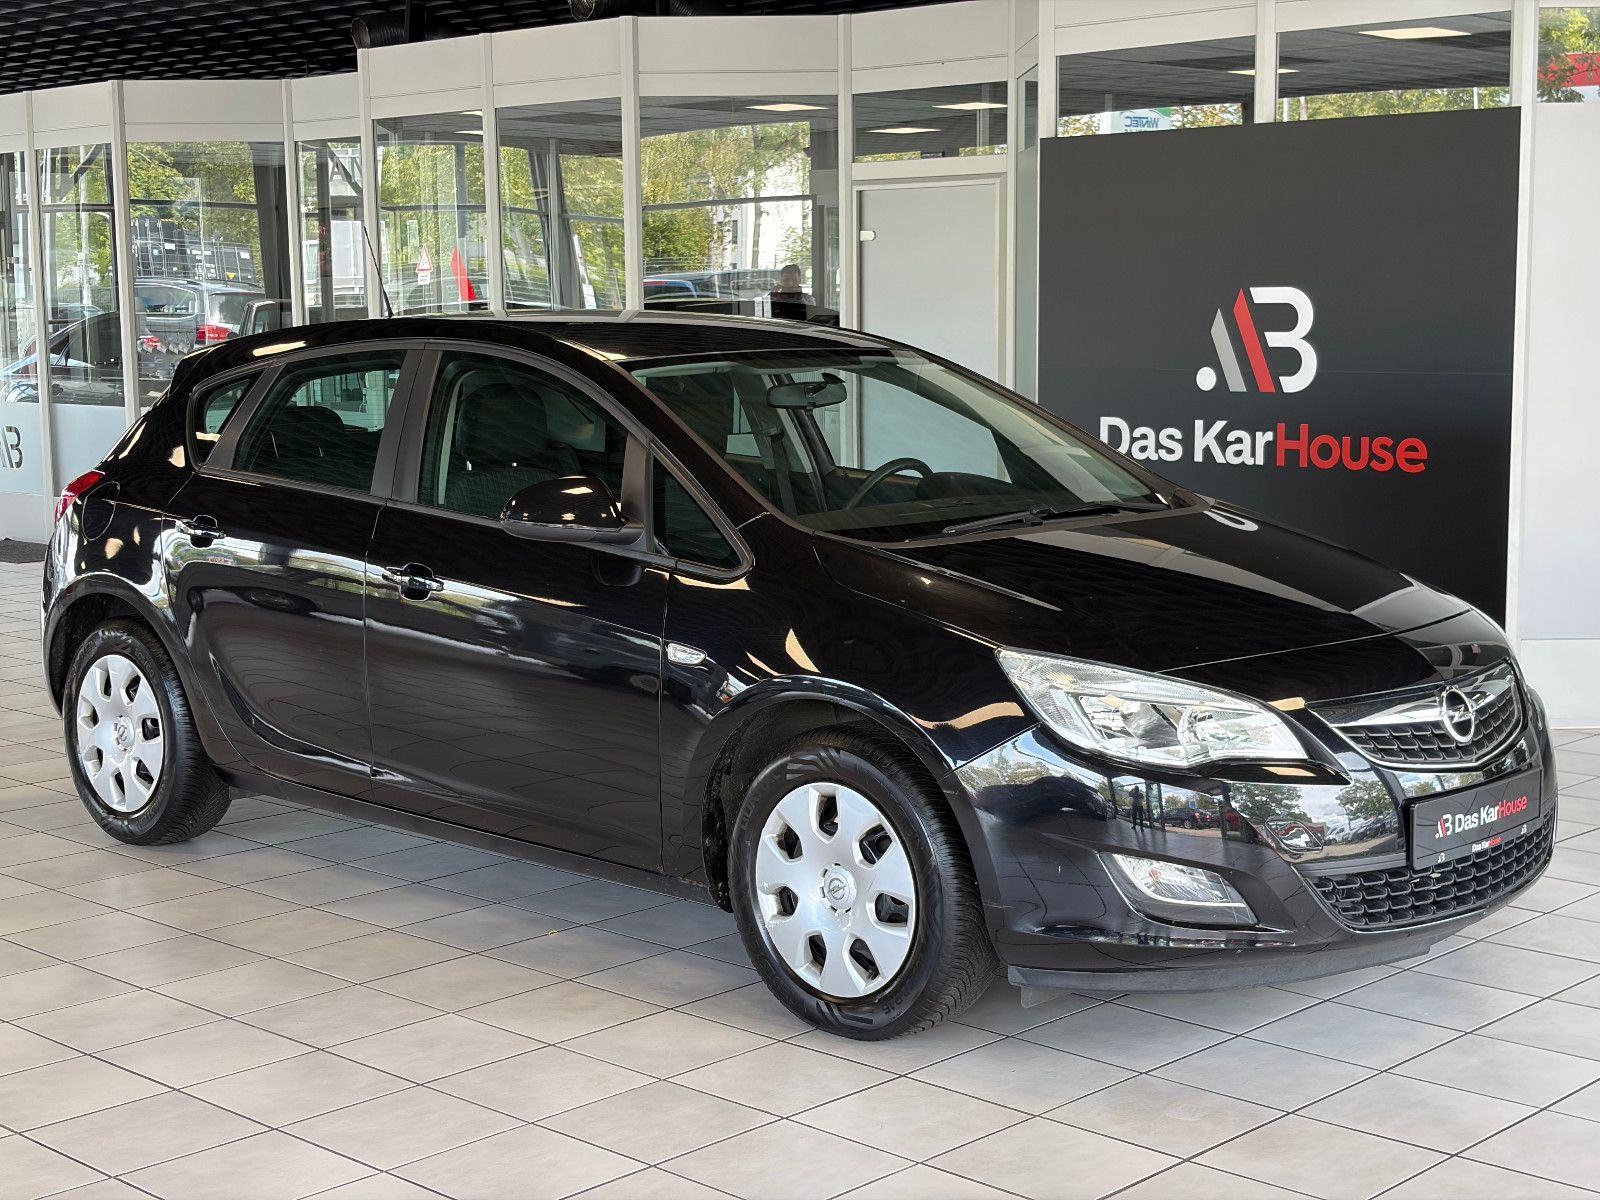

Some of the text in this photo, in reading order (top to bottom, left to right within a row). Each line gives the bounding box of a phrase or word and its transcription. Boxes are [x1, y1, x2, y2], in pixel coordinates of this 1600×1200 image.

[1099, 416, 1428, 474] Das KarHouse
[1455, 812, 1479, 833] Das
[1480, 796, 1528, 825] KarHouse
[1472, 844, 1482, 852] Das
